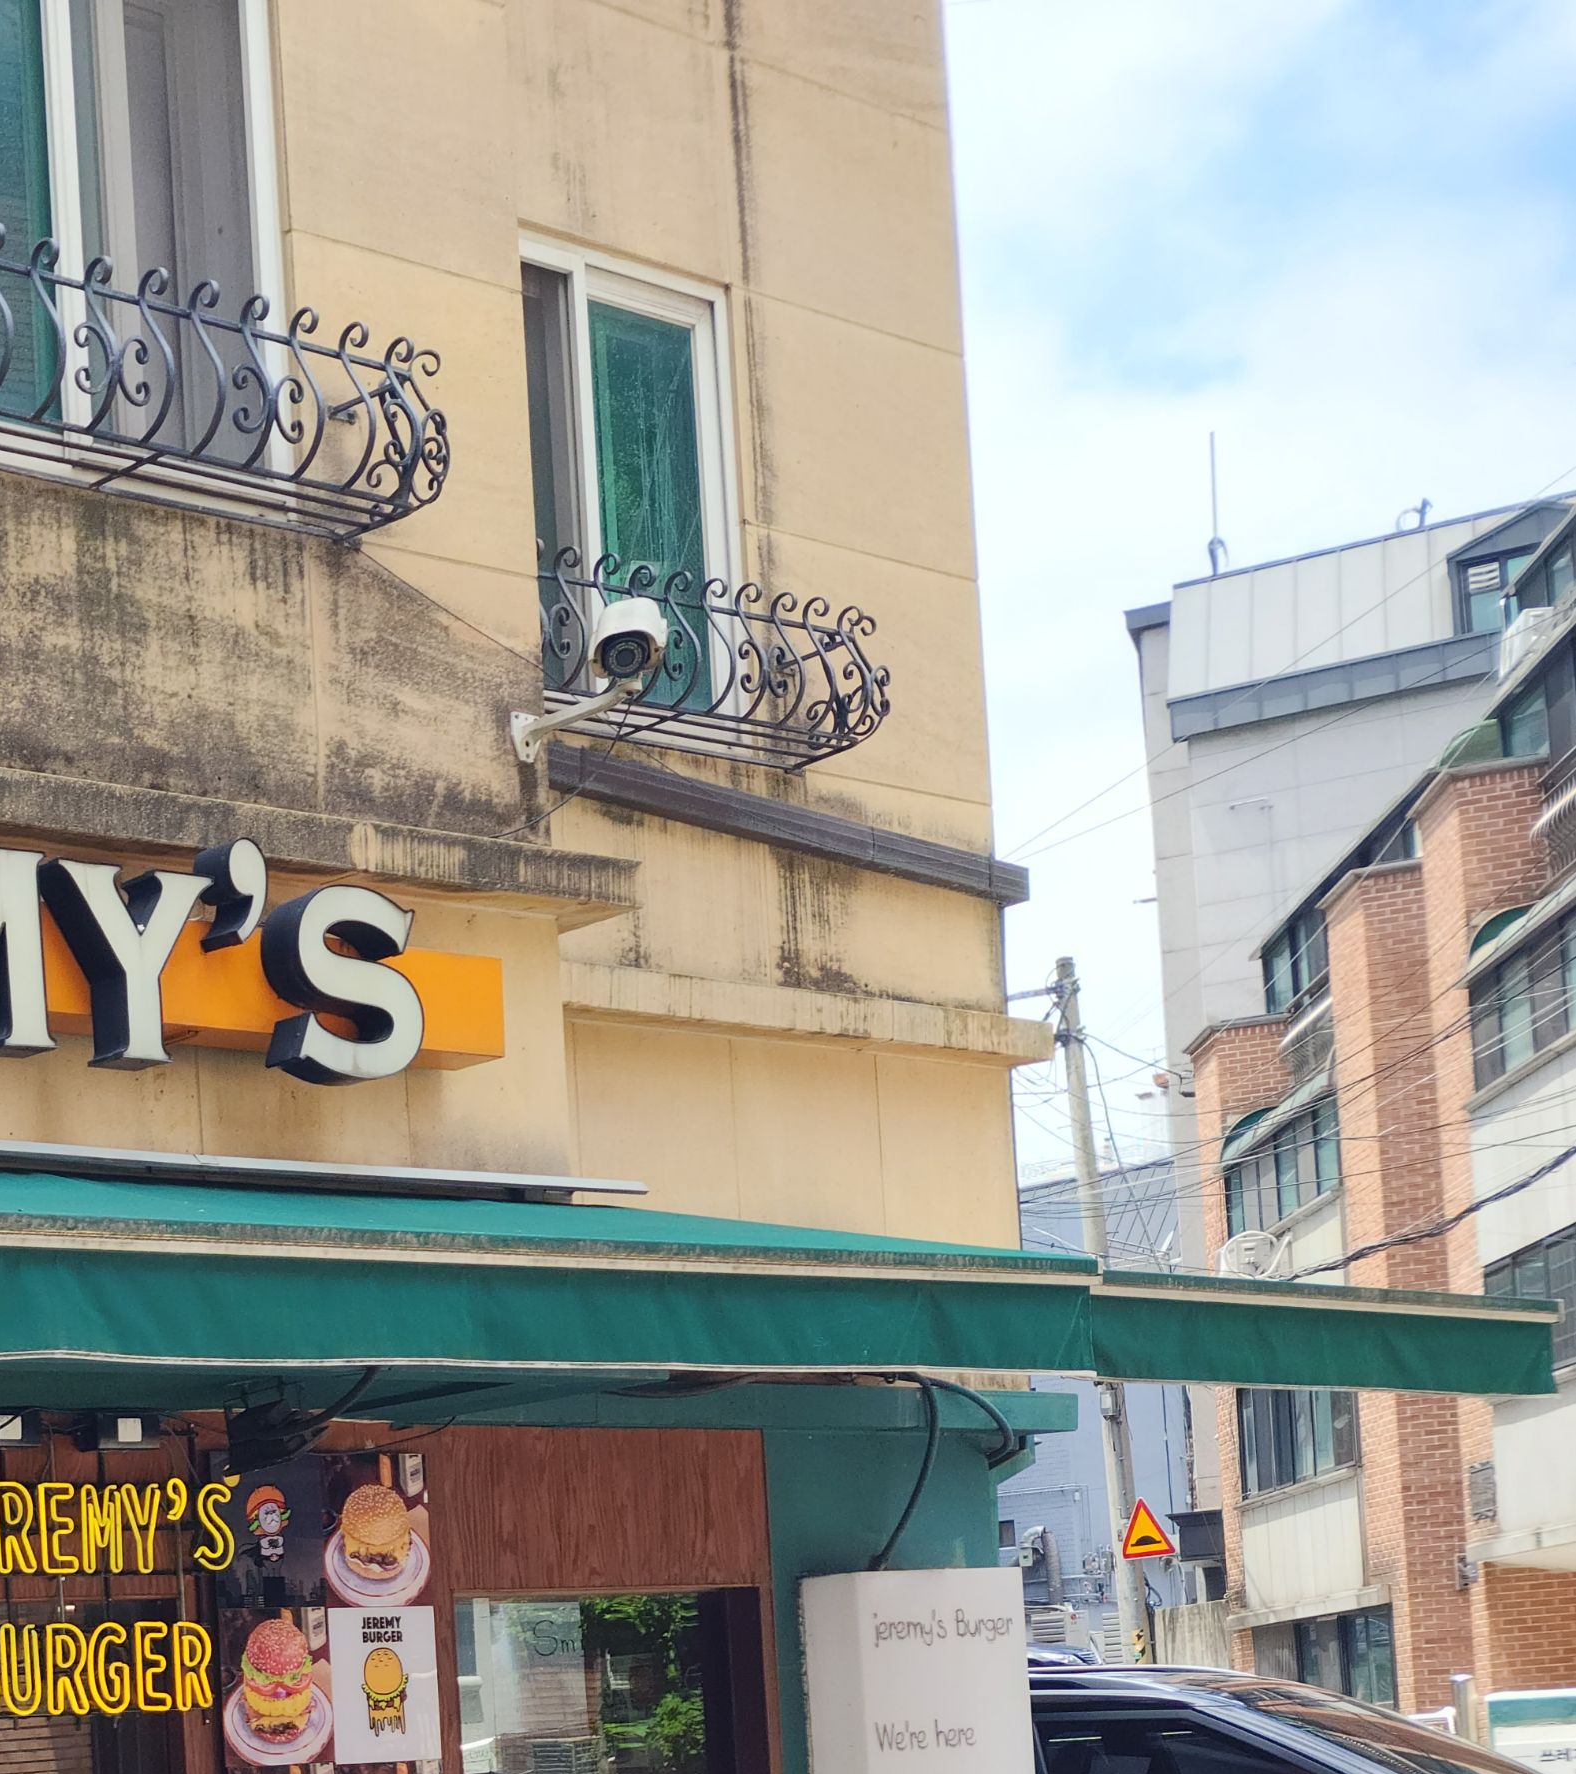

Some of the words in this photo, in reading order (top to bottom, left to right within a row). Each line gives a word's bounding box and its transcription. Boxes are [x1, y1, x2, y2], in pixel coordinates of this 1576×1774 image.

[361, 1615, 402, 1630] JEREMY
[954, 1608, 1013, 1642] Burger
[362, 1629, 403, 1643] BURGER
[874, 1720, 928, 1752] We're
[934, 1719, 976, 1749] here
[1540, 1747, 1576, 1763] 쓰레
